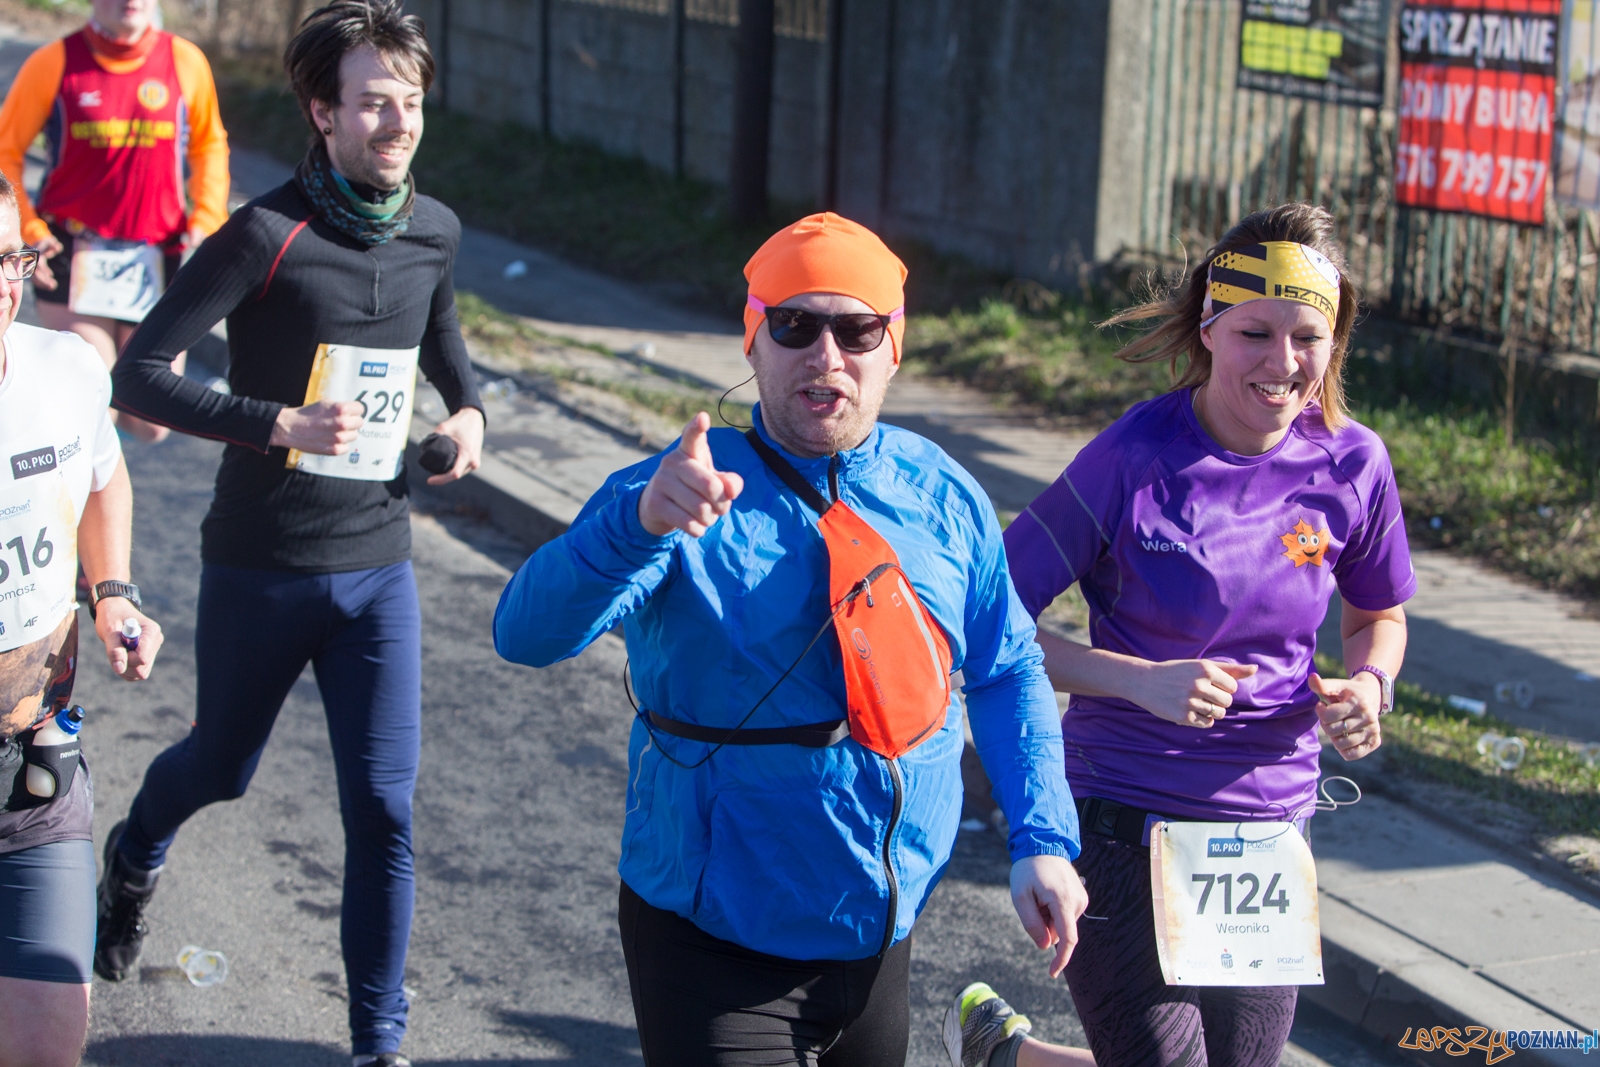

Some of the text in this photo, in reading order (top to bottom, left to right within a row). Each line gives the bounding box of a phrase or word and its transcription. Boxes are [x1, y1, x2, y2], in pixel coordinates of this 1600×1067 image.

[1401, 9, 1554, 68] SPRZĄTANIE
[1440, 149, 1494, 195] 799
[1497, 156, 1546, 201] 757
[372, 365, 387, 374] PKO
[16, 452, 54, 472] 10. PKO
[1141, 540, 1187, 553] Wera
[1222, 842, 1240, 852] PKO
[1192, 872, 1290, 915] 7124
[1216, 923, 1270, 934] Weronika
